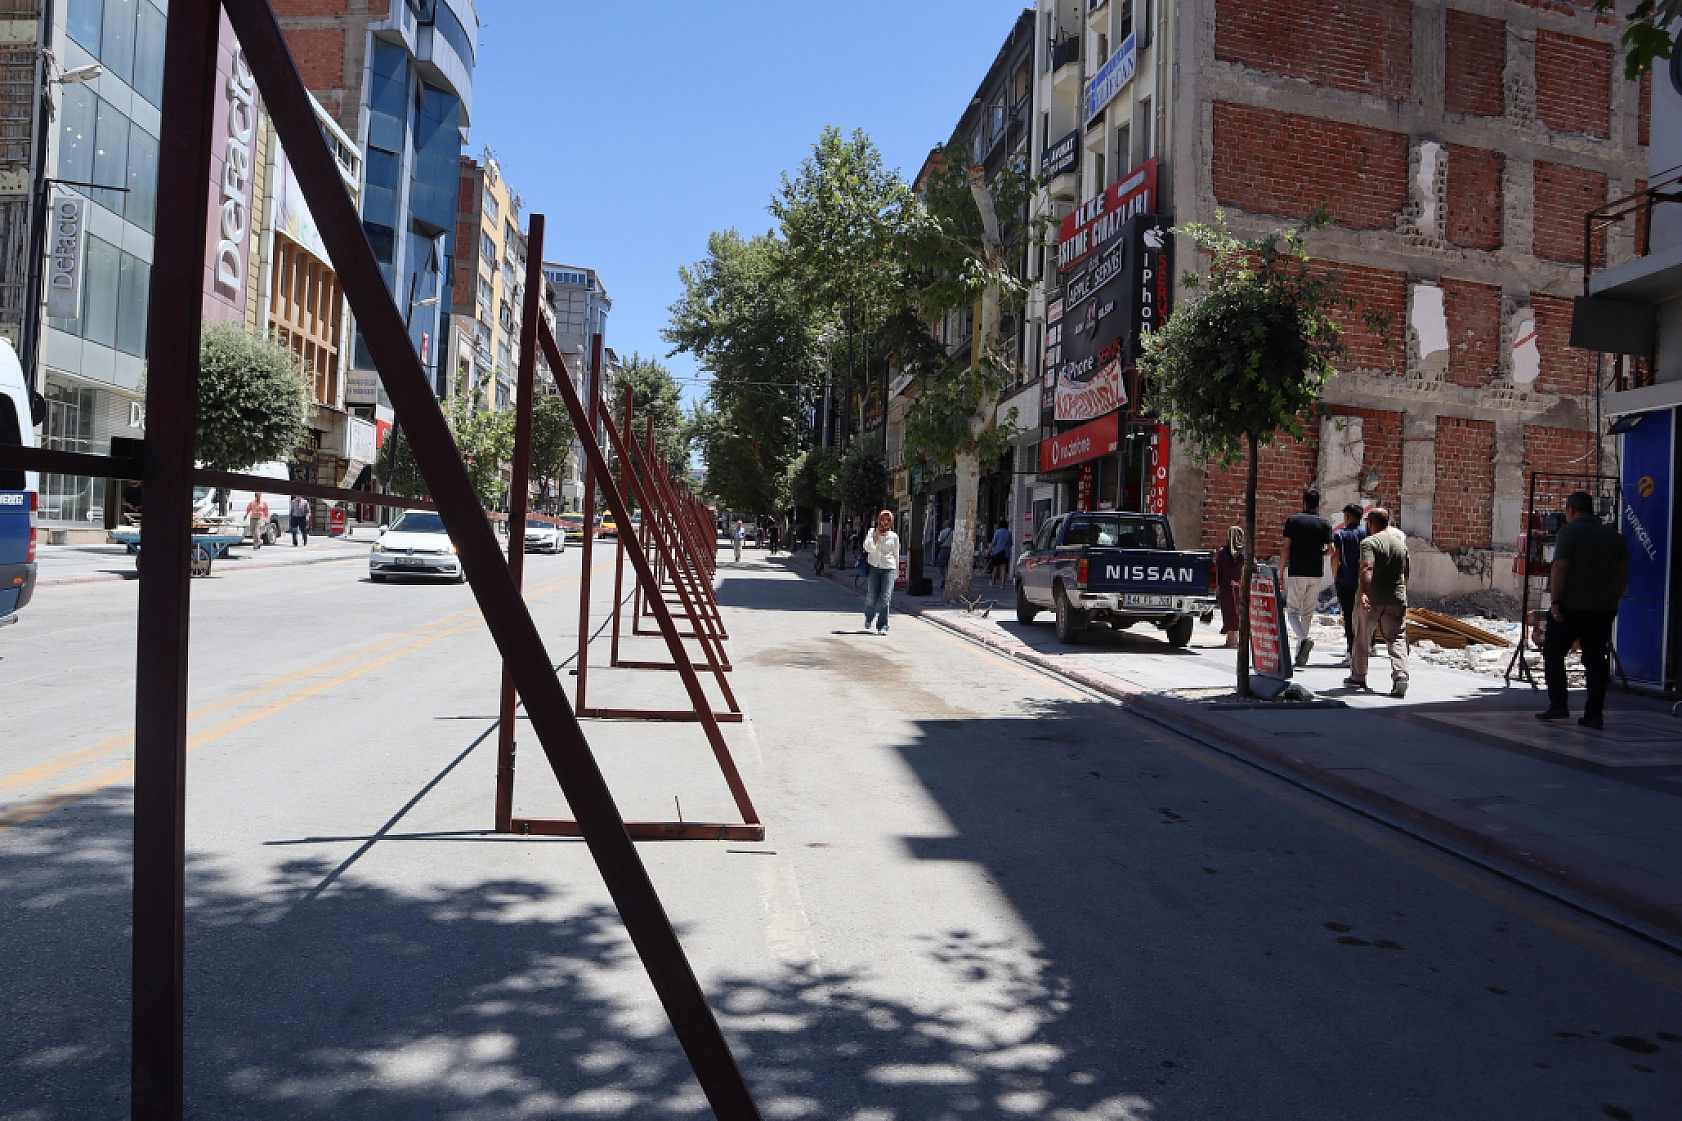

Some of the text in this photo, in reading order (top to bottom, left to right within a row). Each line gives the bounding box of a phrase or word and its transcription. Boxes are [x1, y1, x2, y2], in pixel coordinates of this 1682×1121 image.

[52, 199, 78, 291] DeFacto
[1624, 503, 1657, 562] TURKCELL
[1105, 564, 1193, 583] NISSAN
